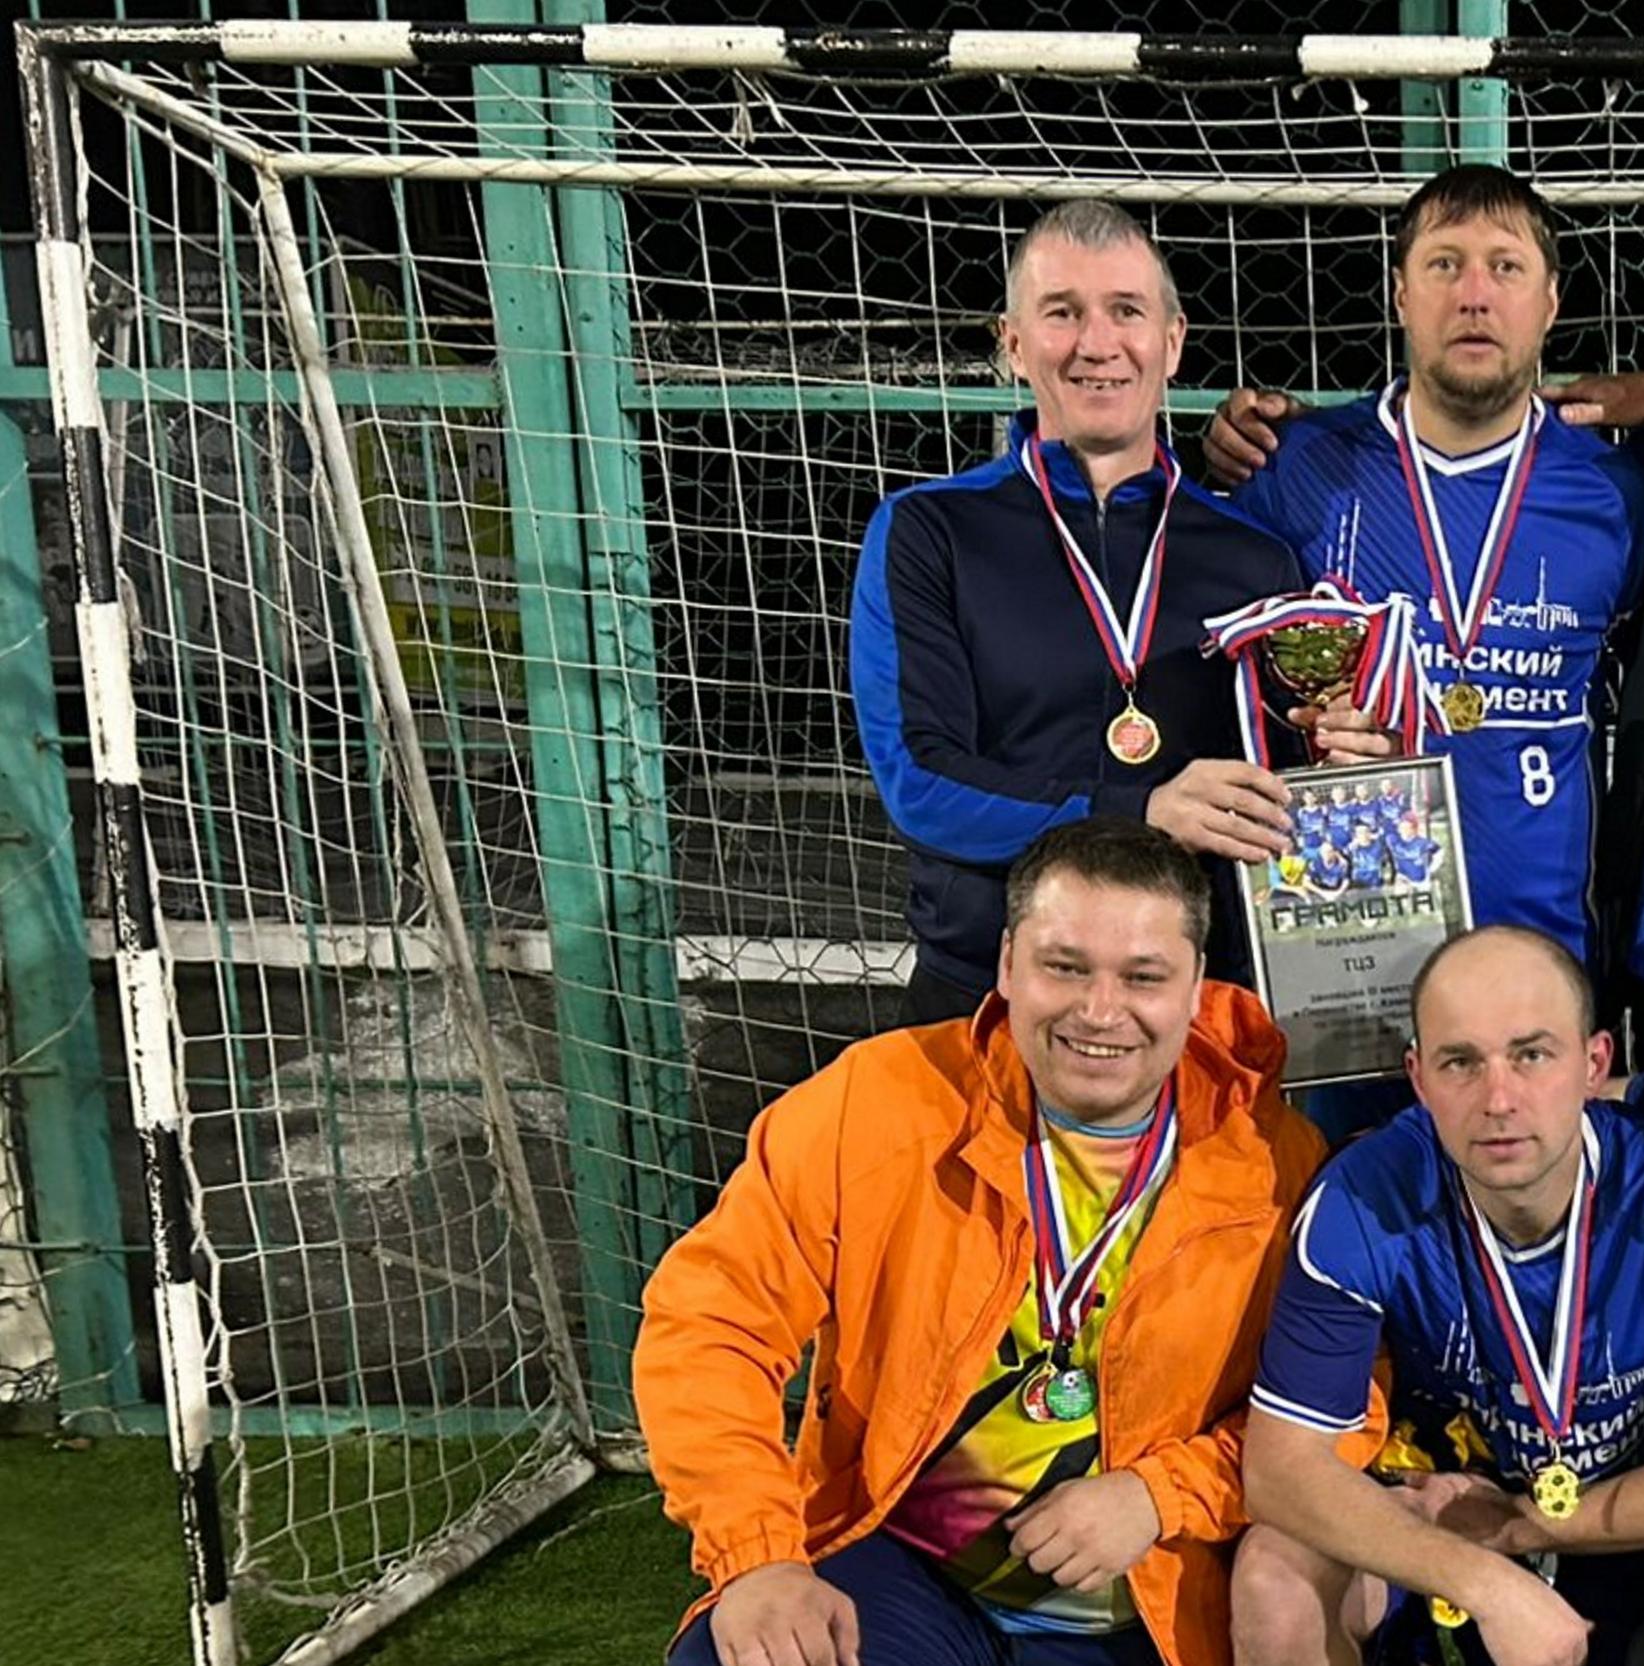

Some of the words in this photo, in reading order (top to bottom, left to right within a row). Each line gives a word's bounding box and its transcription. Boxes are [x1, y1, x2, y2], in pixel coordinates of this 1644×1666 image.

[1418, 644, 1562, 677] инский
[1433, 682, 1568, 713] мент
[1519, 746, 1555, 807] 8
[1270, 892, 1435, 930] ГРАМОТА
